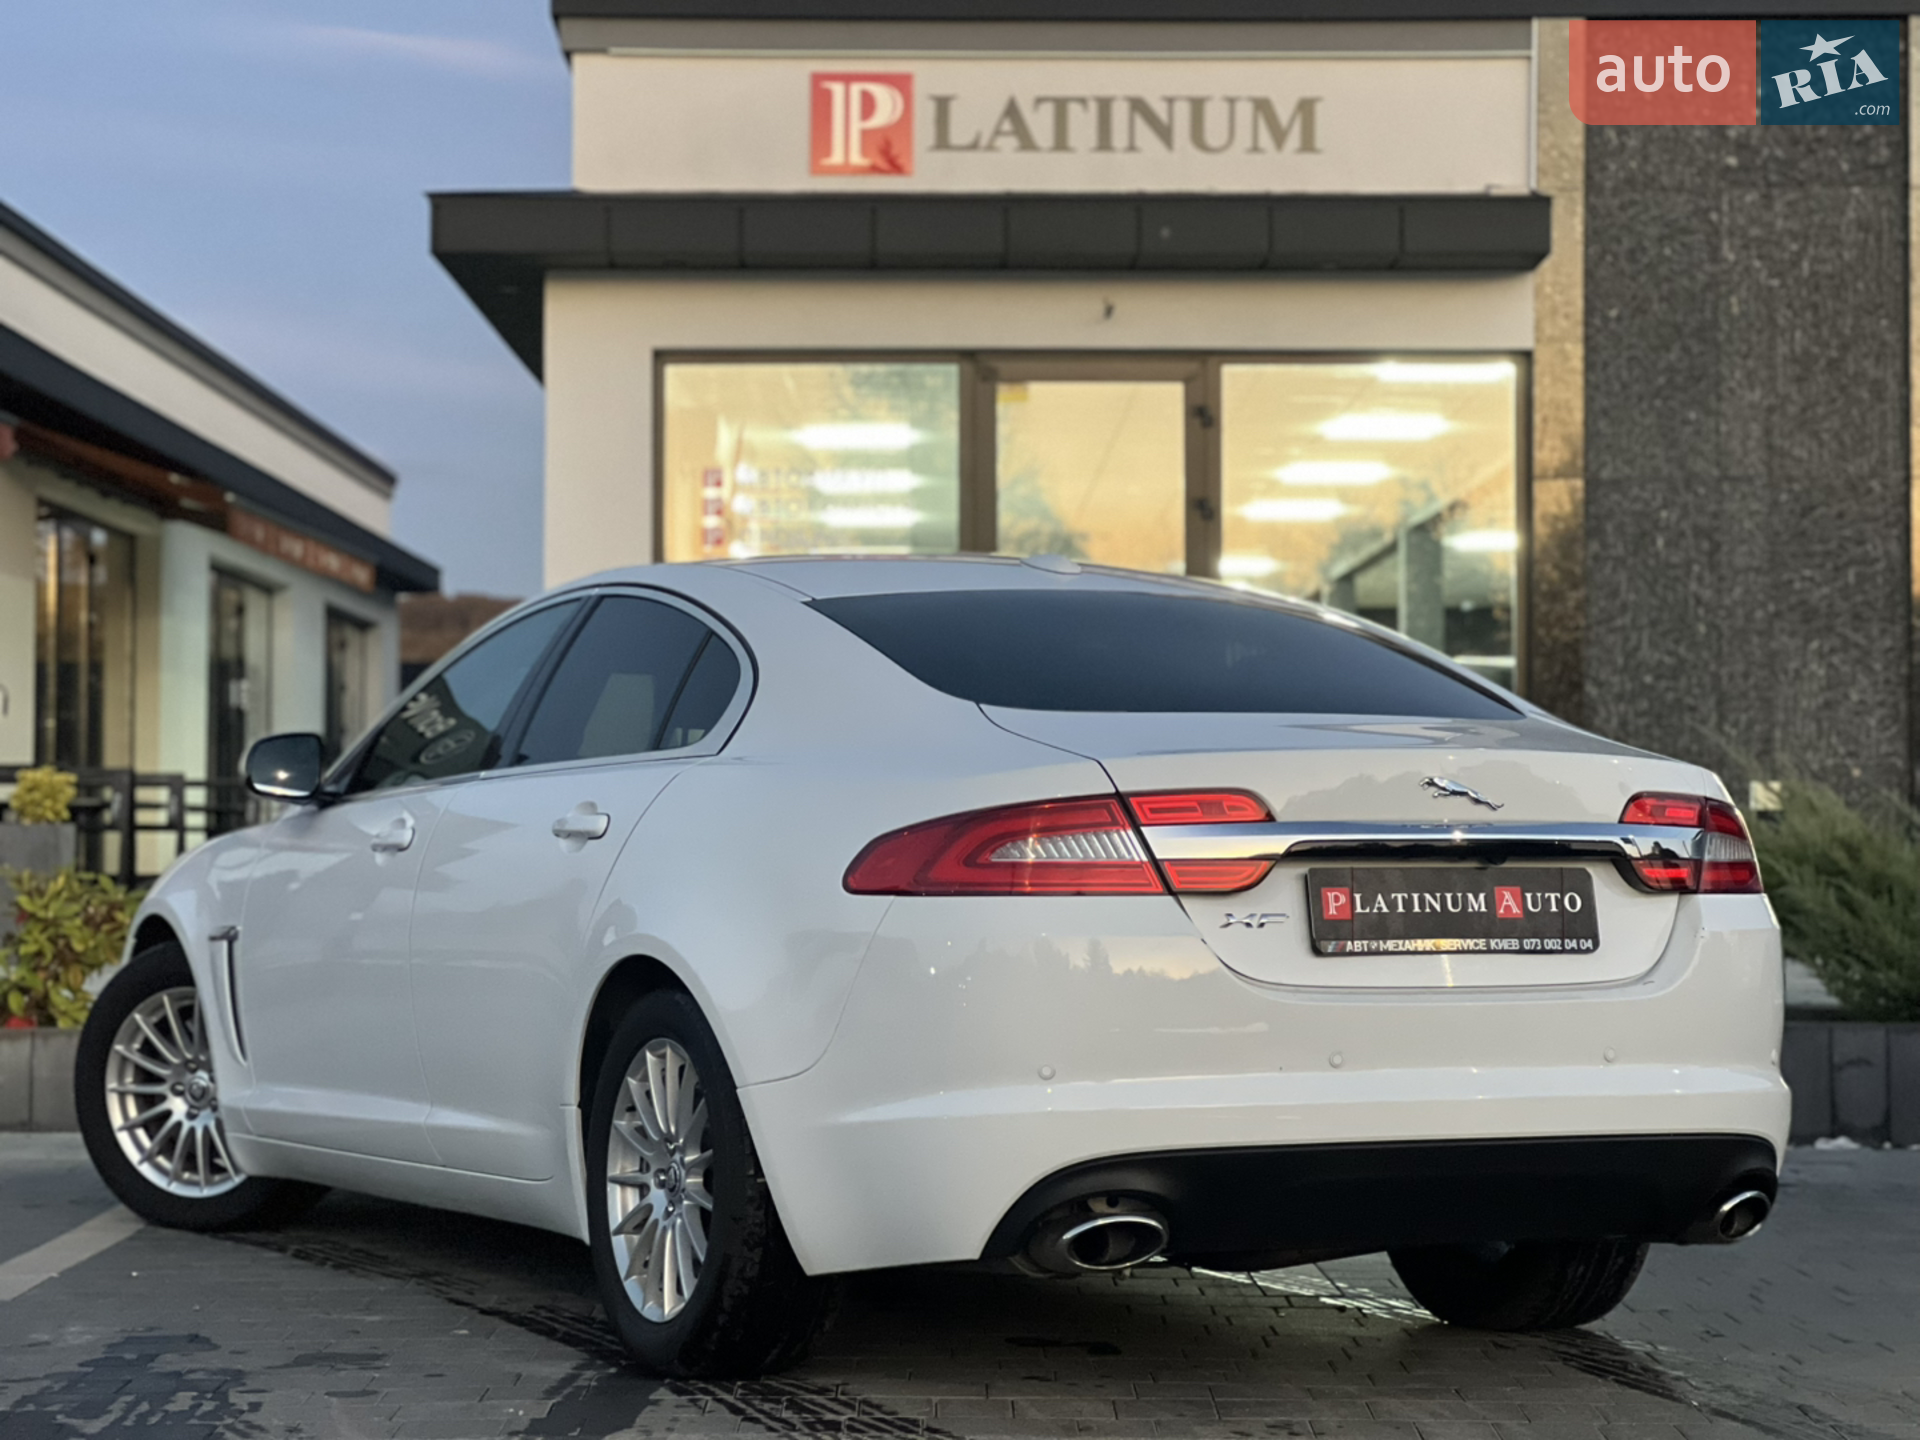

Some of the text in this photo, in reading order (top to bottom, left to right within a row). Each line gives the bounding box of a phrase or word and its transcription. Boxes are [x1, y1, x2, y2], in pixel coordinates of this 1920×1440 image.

[819, 80, 1323, 167] PLATINUM
[1325, 889, 1583, 916] PLATINUM AUTO
[1219, 912, 1288, 929] XF
[1440, 939, 1487, 951] SERVICE
[1490, 939, 1520, 950] КИЕВ
[1523, 939, 1542, 950] 073
[1543, 939, 1563, 950] 002
[1564, 939, 1578, 950] 04
[1579, 939, 1594, 950] 04
